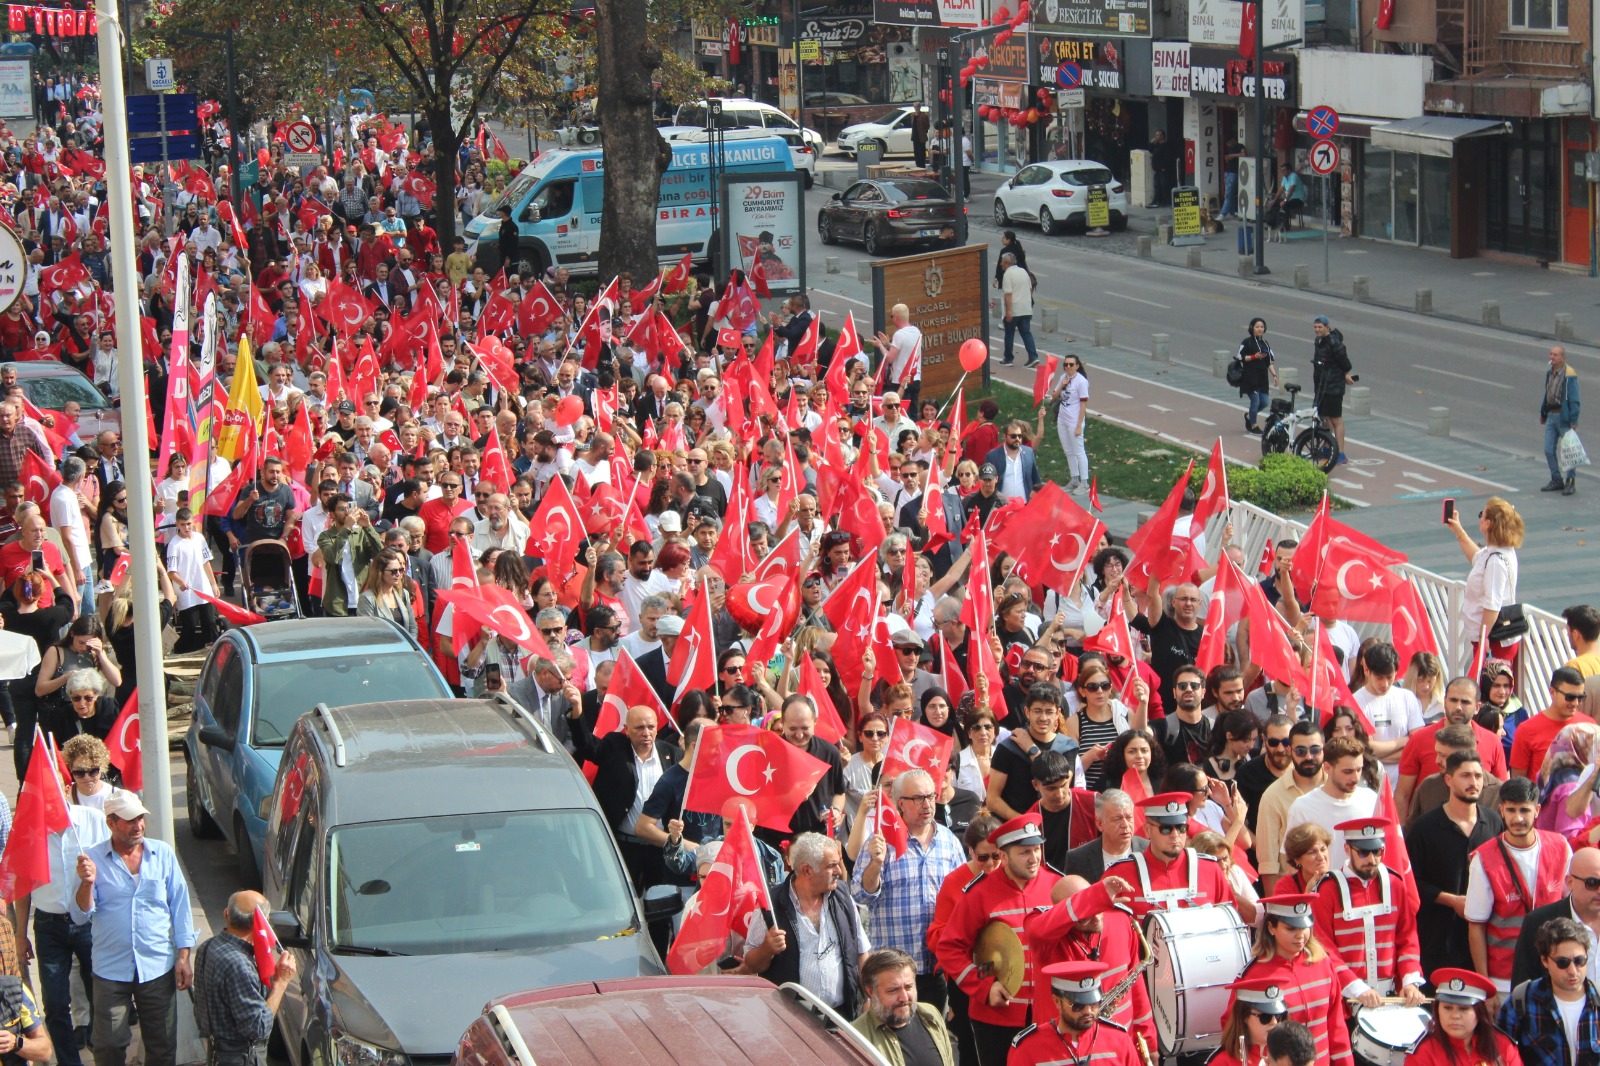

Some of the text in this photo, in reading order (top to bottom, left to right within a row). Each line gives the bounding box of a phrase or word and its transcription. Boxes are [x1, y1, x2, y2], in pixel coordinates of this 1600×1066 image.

[1083, 42, 1093, 60] ET
[1099, 70, 1120, 88] SUCUK
[1191, 66, 1224, 93] EMRE
[1242, 76, 1285, 100] CETER
[672, 146, 775, 169] İLÇE BAKANLIĞI
[689, 173, 705, 183] bir
[684, 188, 712, 201] çoğu
[744, 185, 785, 199] 29 Ekim
[743, 199, 784, 207] CUMHURİYET
[660, 208, 689, 220] BİR
[916, 301, 952, 314] KOCAELİ
[948, 327, 982, 344] BULVARI
[923, 354, 945, 366] 2021
